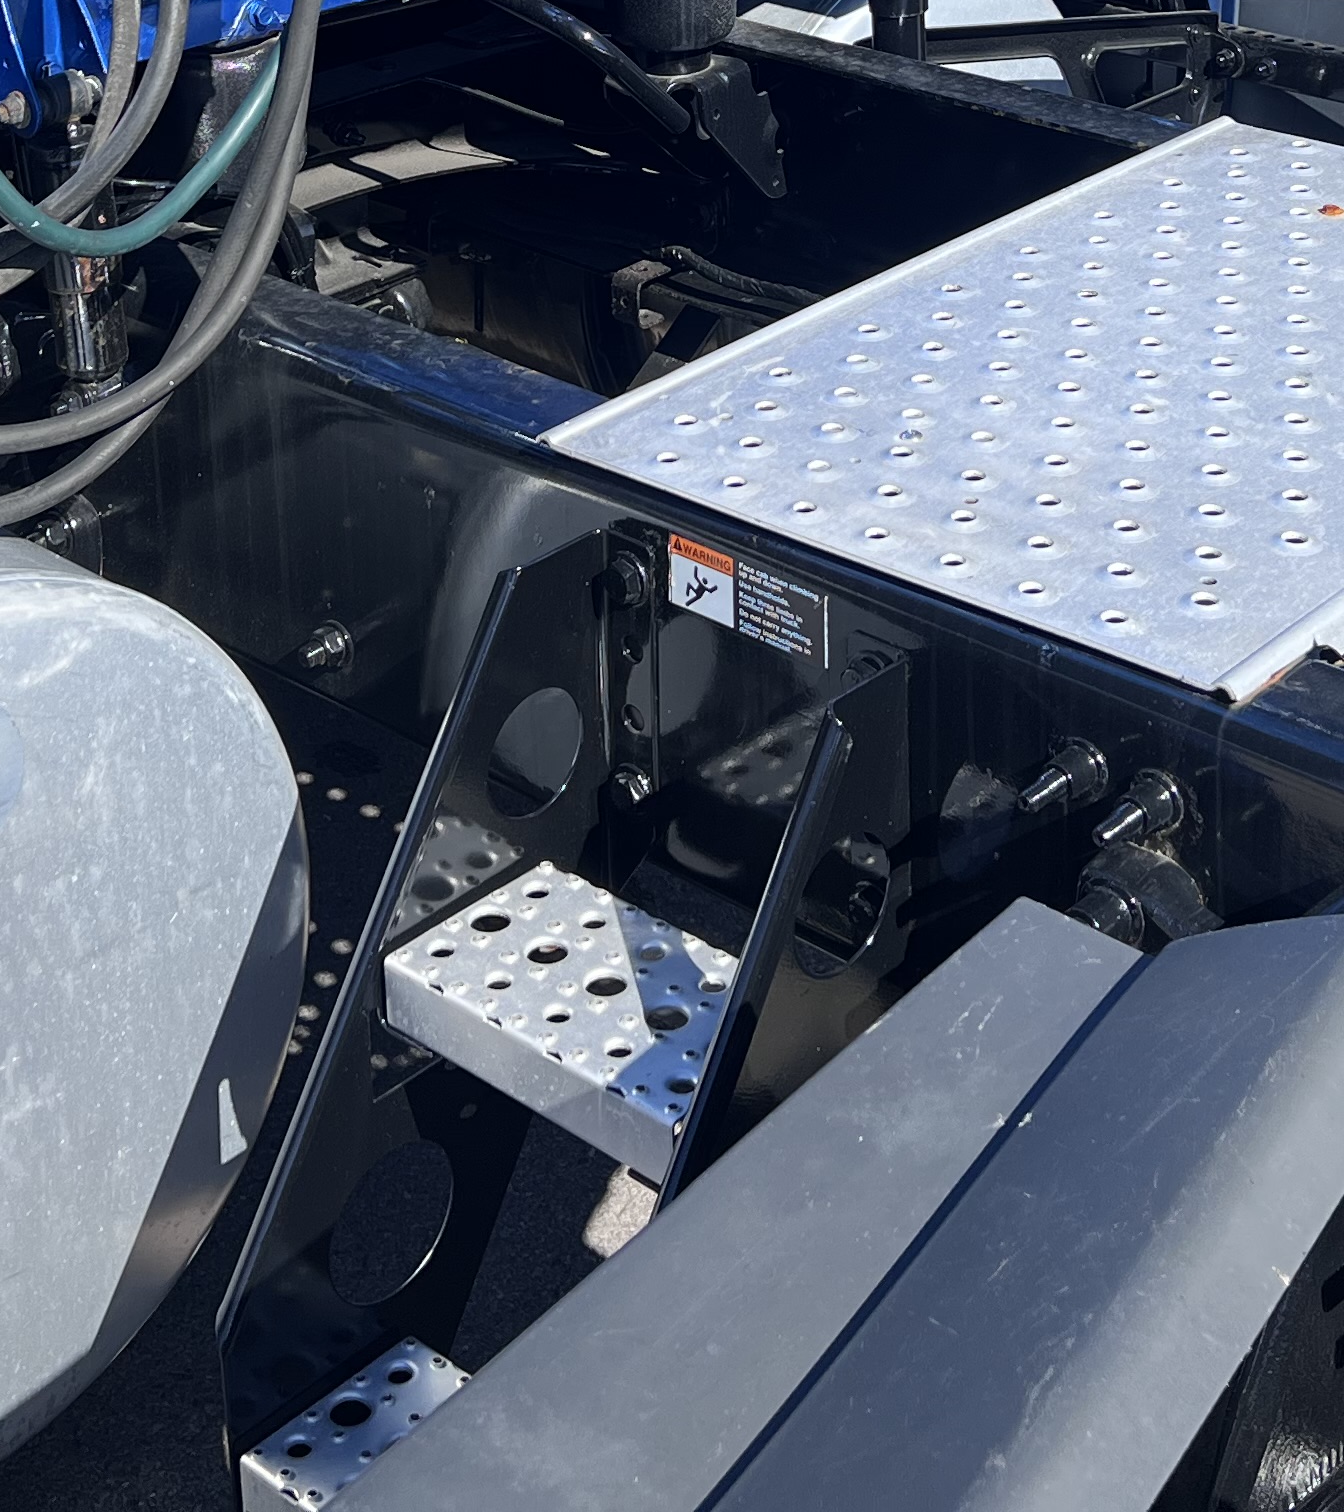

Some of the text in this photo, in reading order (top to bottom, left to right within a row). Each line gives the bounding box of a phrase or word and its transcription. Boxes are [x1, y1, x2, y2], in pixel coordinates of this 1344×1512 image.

[682, 542, 731, 571] WARNING
[738, 569, 748, 579] up
[748, 574, 762, 584] and
[738, 580, 752, 591] Use
[739, 562, 755, 575] Face
[769, 575, 788, 588] when
[789, 584, 819, 602] climbing
[738, 590, 756, 604] Keep
[757, 598, 775, 611] three
[795, 614, 803, 624] in
[738, 599, 764, 614] contact
[764, 609, 780, 620] with
[738, 607, 749, 618] Do
[749, 614, 762, 624] not
[762, 619, 780, 633] carry
[738, 618, 812, 656] Follow instructions in
